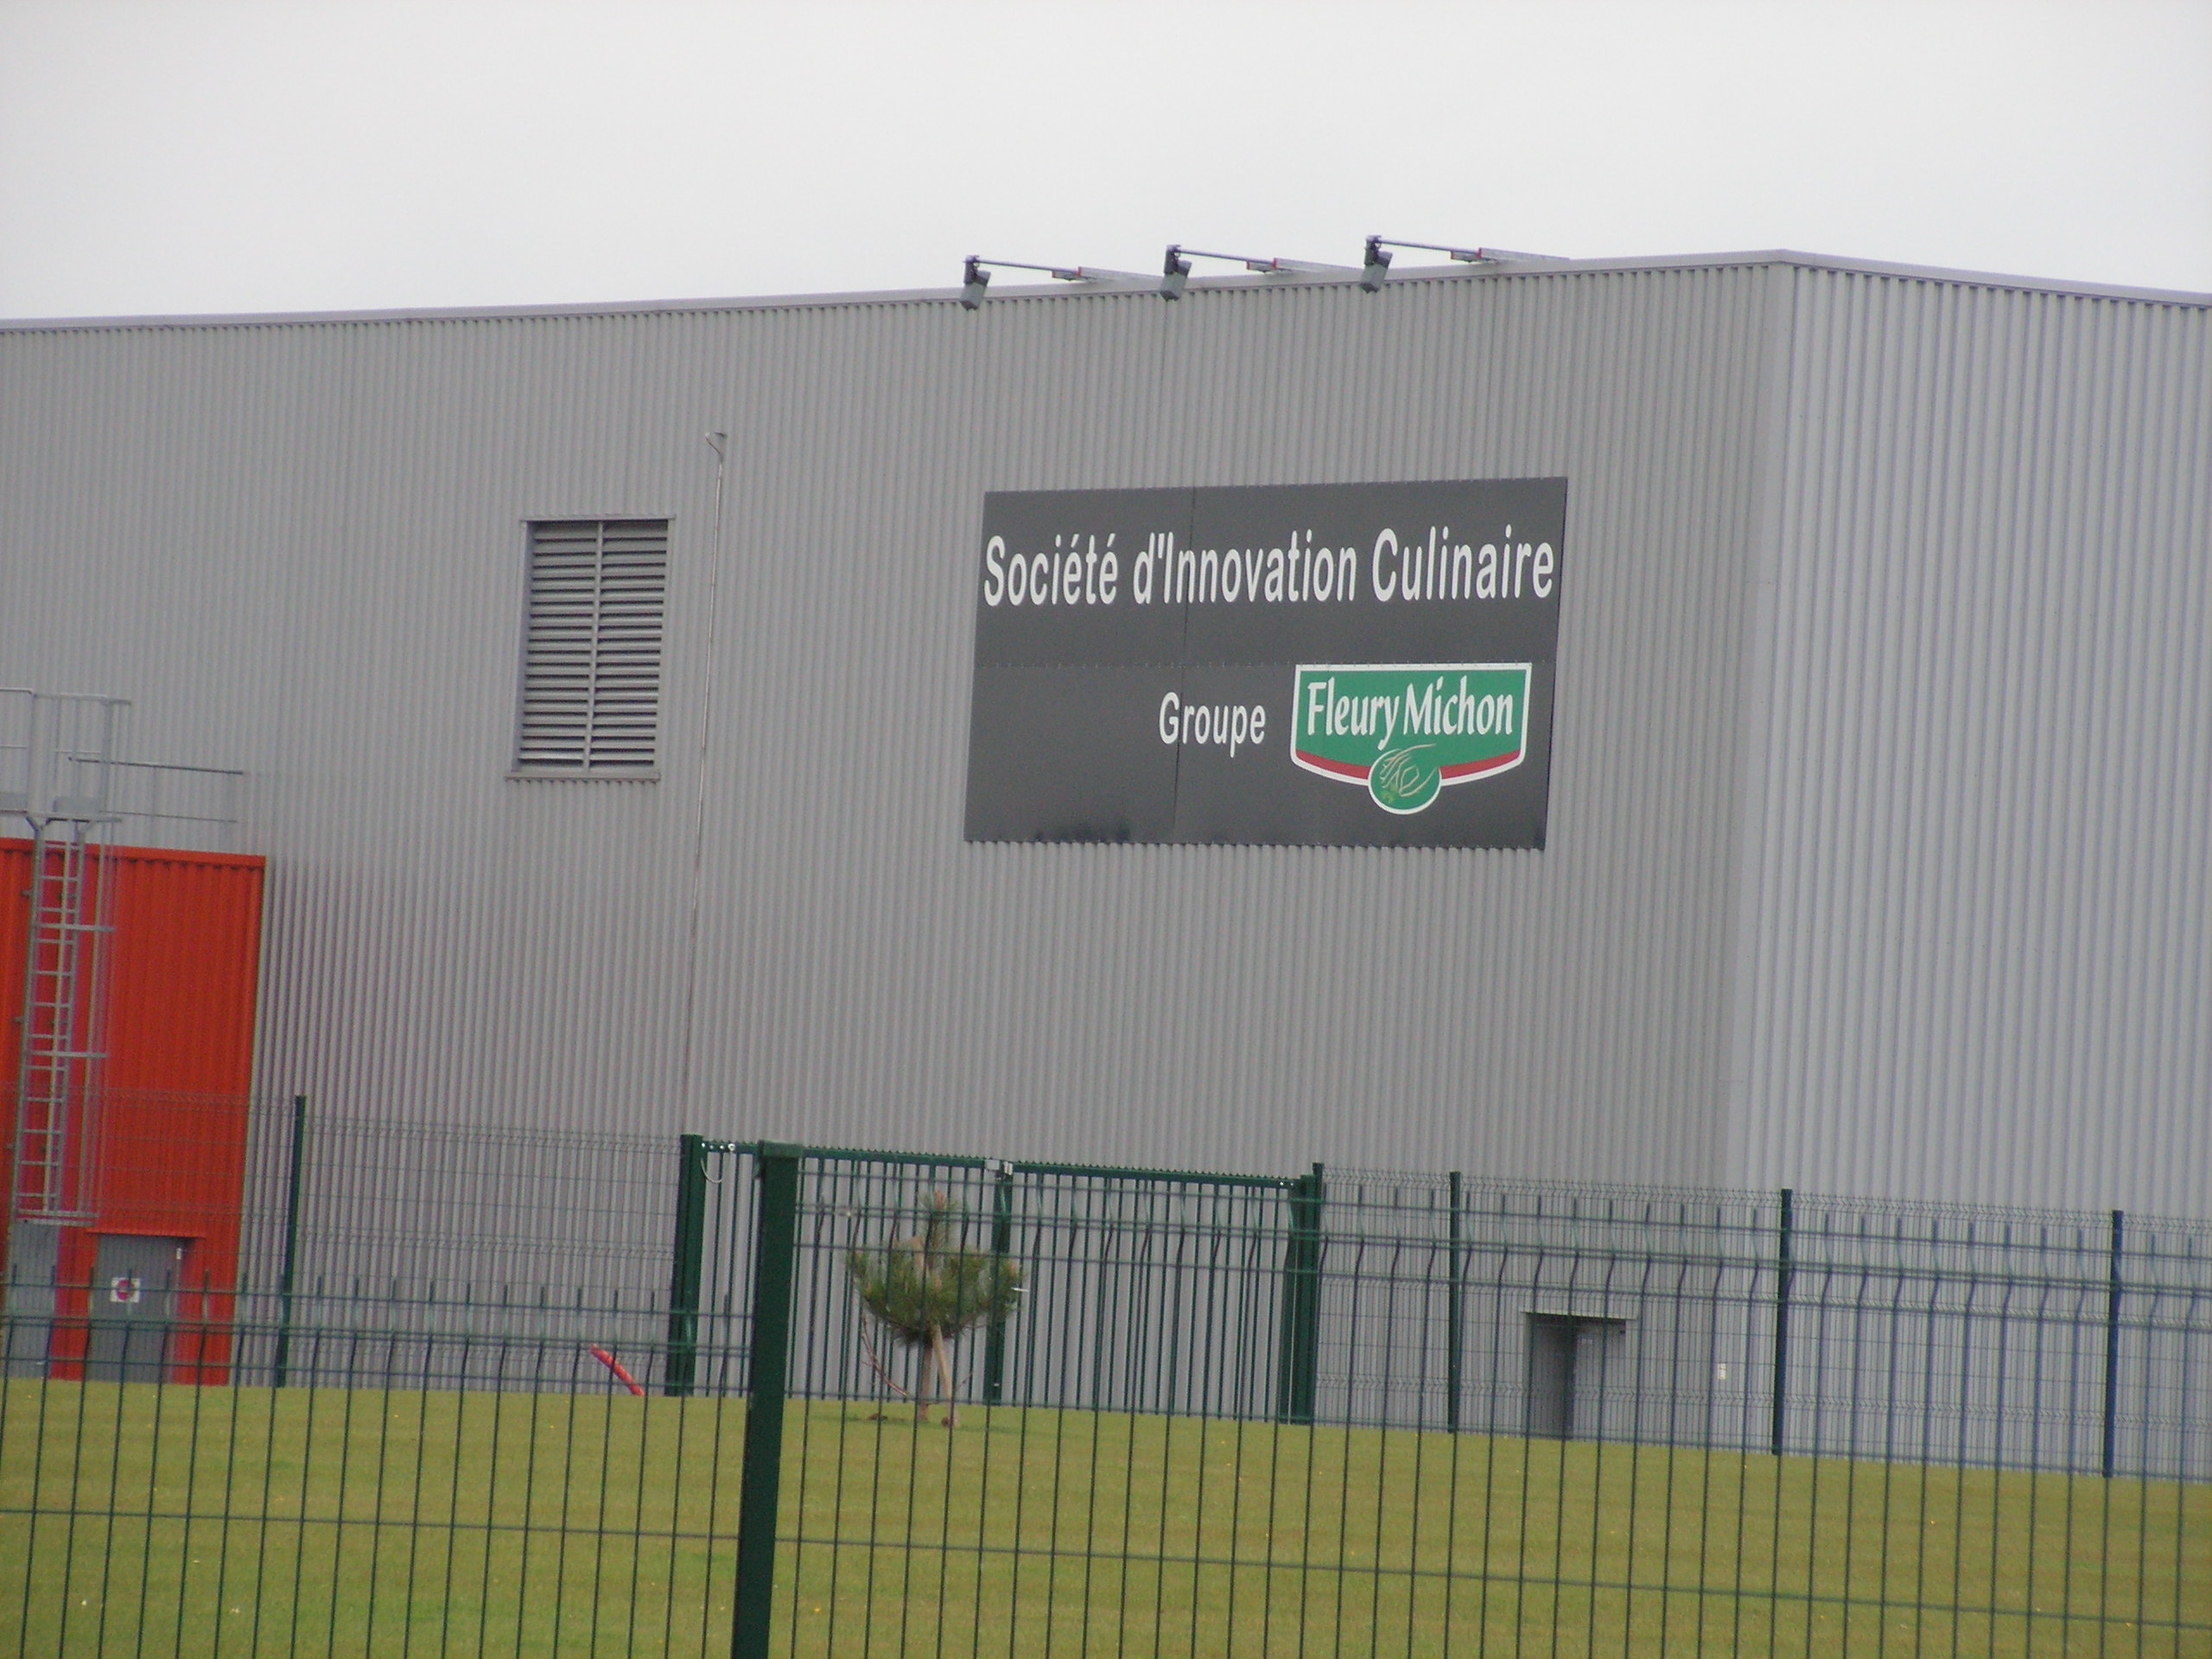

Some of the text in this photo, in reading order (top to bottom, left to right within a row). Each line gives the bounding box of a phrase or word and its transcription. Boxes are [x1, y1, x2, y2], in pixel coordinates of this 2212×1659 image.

[983, 524, 1555, 607] Société d'Innovation Culinaire
[1158, 675, 1514, 759] Groupe Fleury Michon
